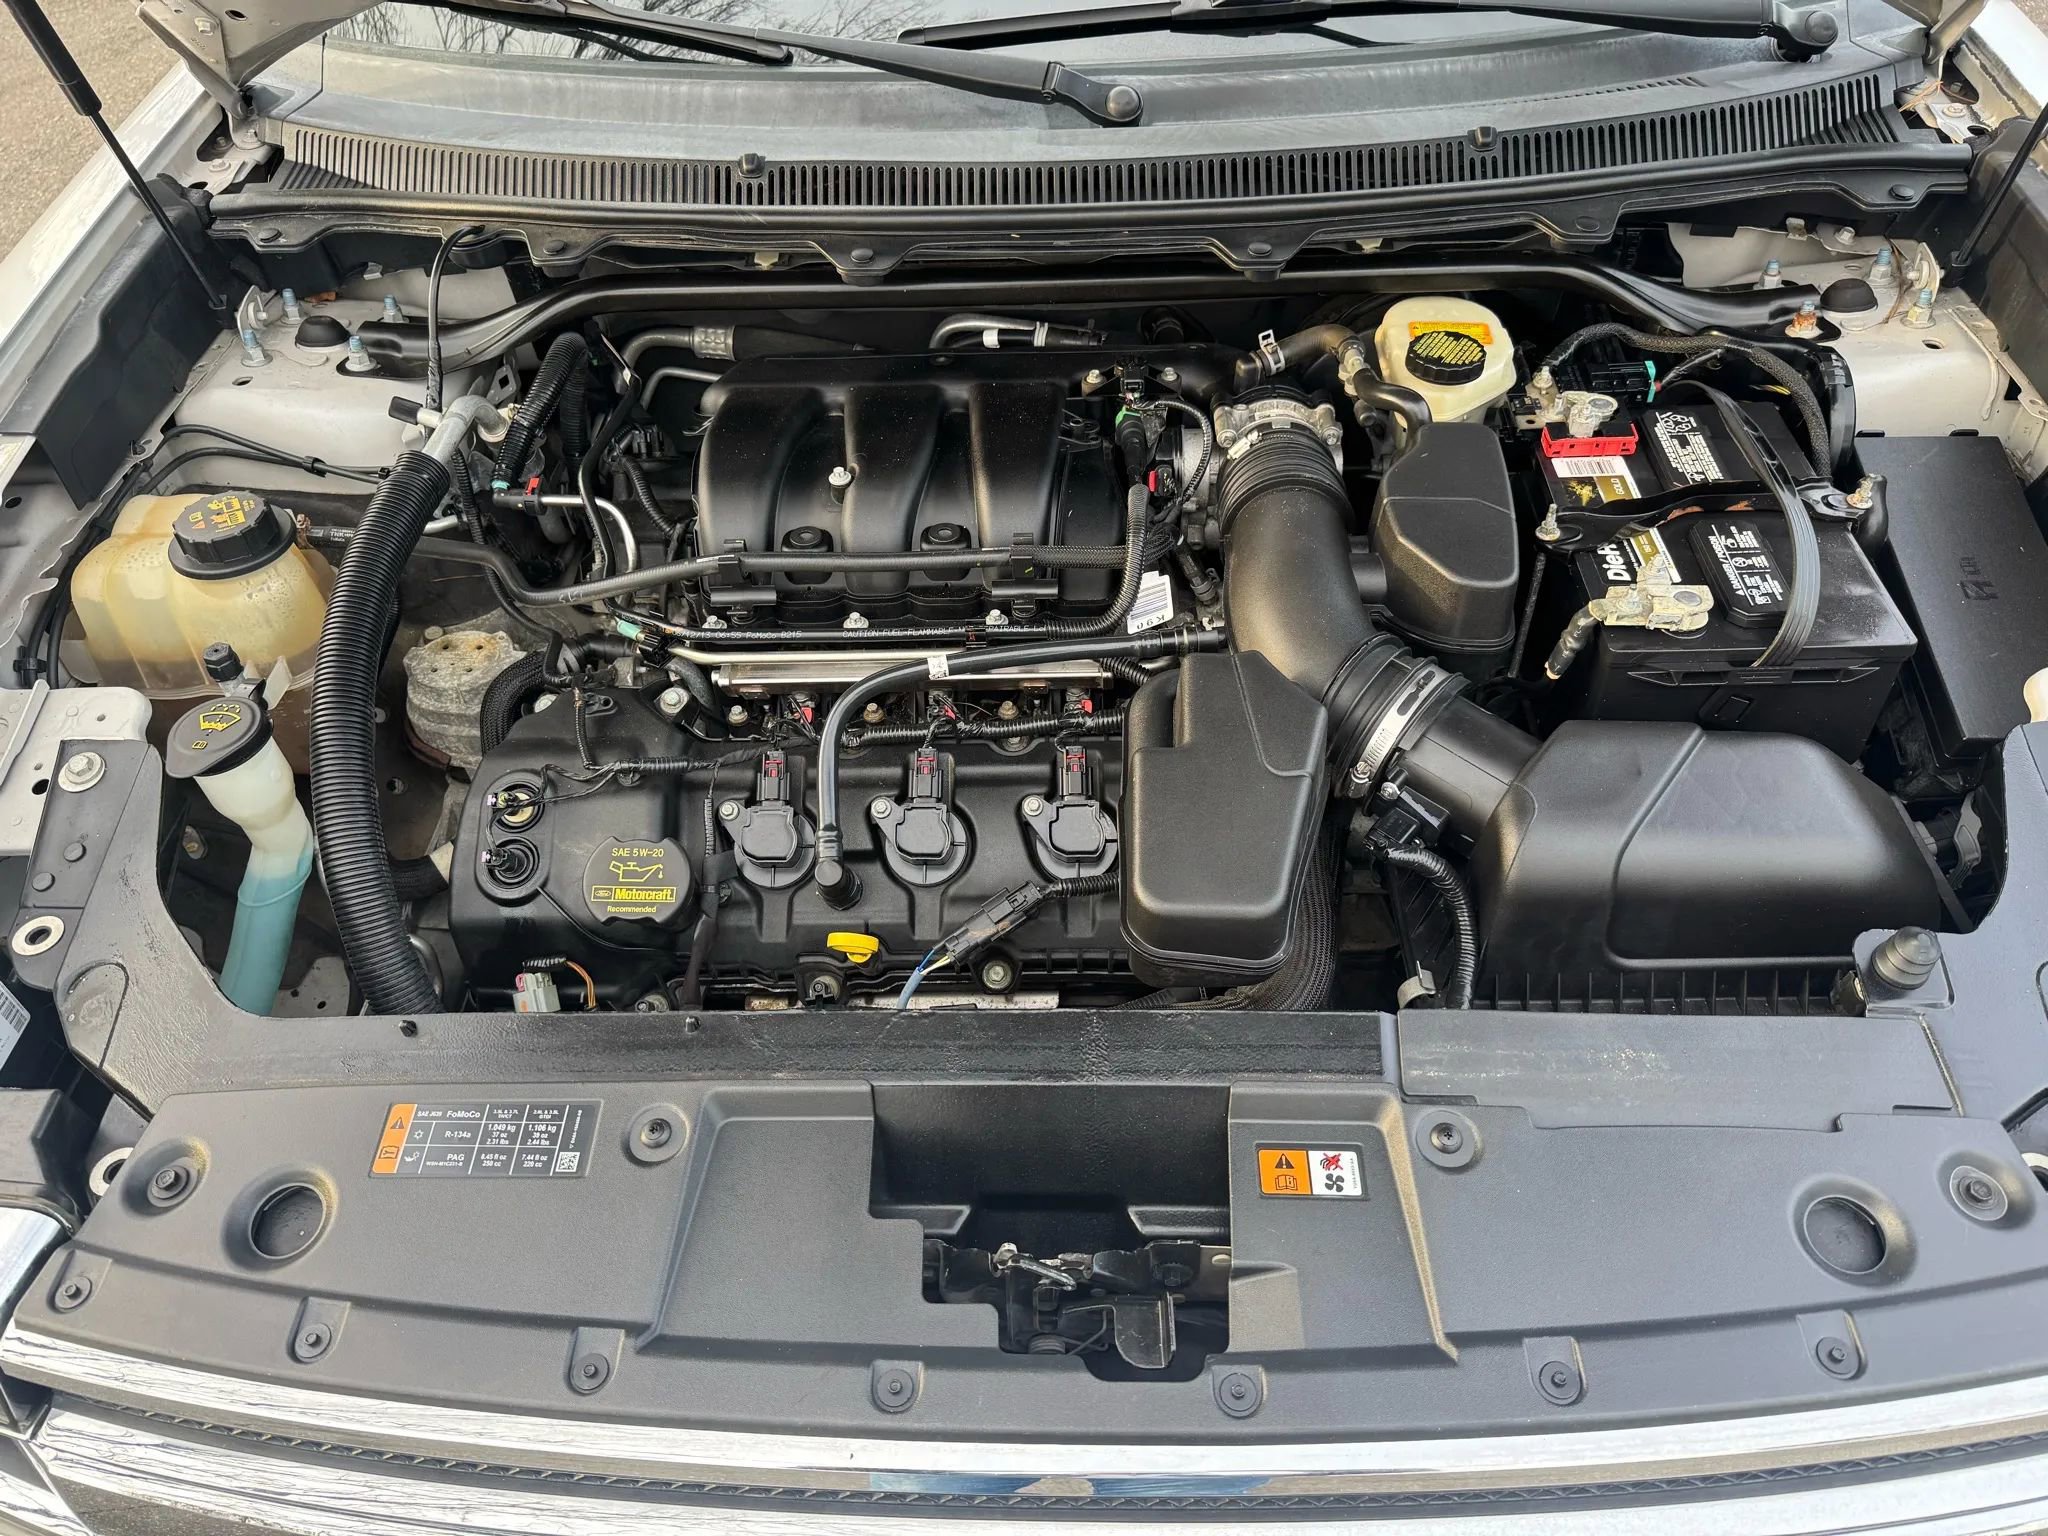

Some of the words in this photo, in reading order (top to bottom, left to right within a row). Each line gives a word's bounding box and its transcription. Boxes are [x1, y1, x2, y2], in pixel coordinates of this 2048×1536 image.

[1708, 535, 1727, 558] POISON
[1721, 563, 1742, 589] DANGER
[842, 629, 879, 638] CAUTION
[882, 628, 903, 637] FUEL
[907, 626, 954, 637] FLAMMABLE
[612, 848, 630, 857] SAE
[632, 848, 664, 858] 5W-20
[446, 1110, 481, 1118] FoMoCo
[488, 1123, 507, 1131] 1.049
[507, 1123, 517, 1133] kg
[547, 1124, 557, 1133] kg
[444, 1130, 472, 1138] R-134a
[527, 1138, 540, 1146] 2.44
[446, 1153, 465, 1161] PAG
